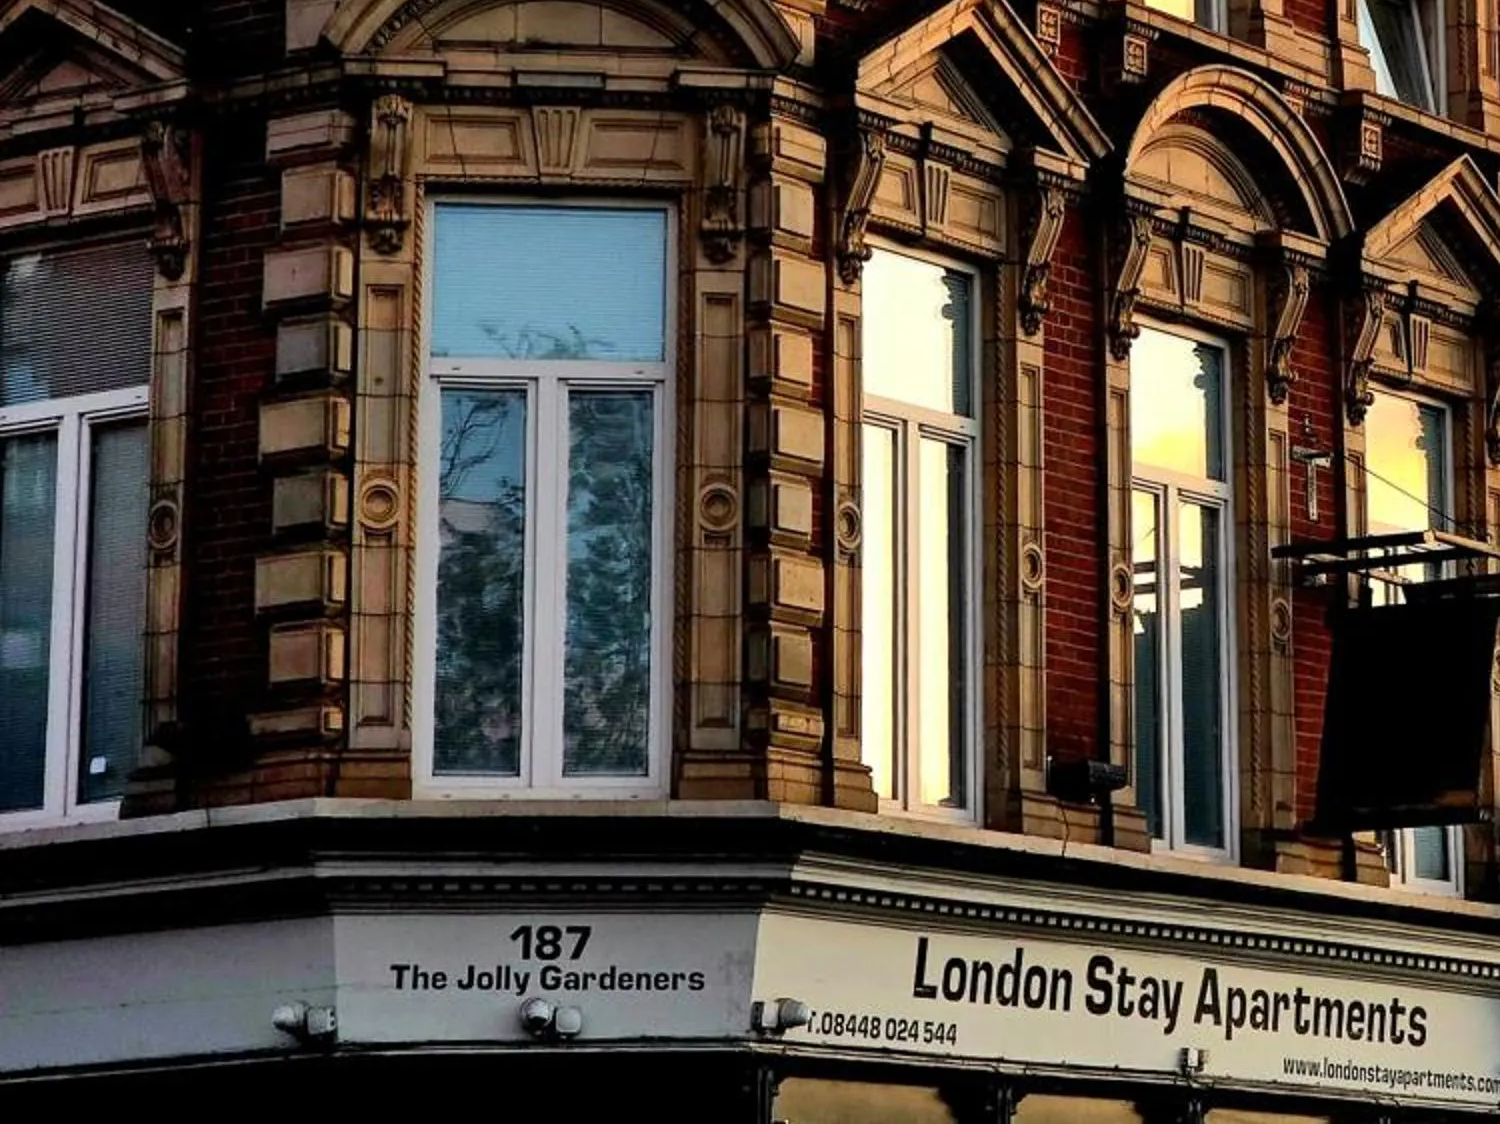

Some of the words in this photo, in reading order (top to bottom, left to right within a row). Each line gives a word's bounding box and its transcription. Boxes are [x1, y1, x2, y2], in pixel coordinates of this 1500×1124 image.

[510, 925, 592, 960] 187
[391, 964, 447, 990] The
[457, 964, 531, 996] Jolly
[539, 965, 705, 991] Gardeners
[913, 937, 1072, 1012] London
[1085, 955, 1184, 1036] Stay
[1193, 967, 1428, 1047] Apartments
[885, 1017, 919, 1043] 024
[923, 1021, 957, 1046] 544
